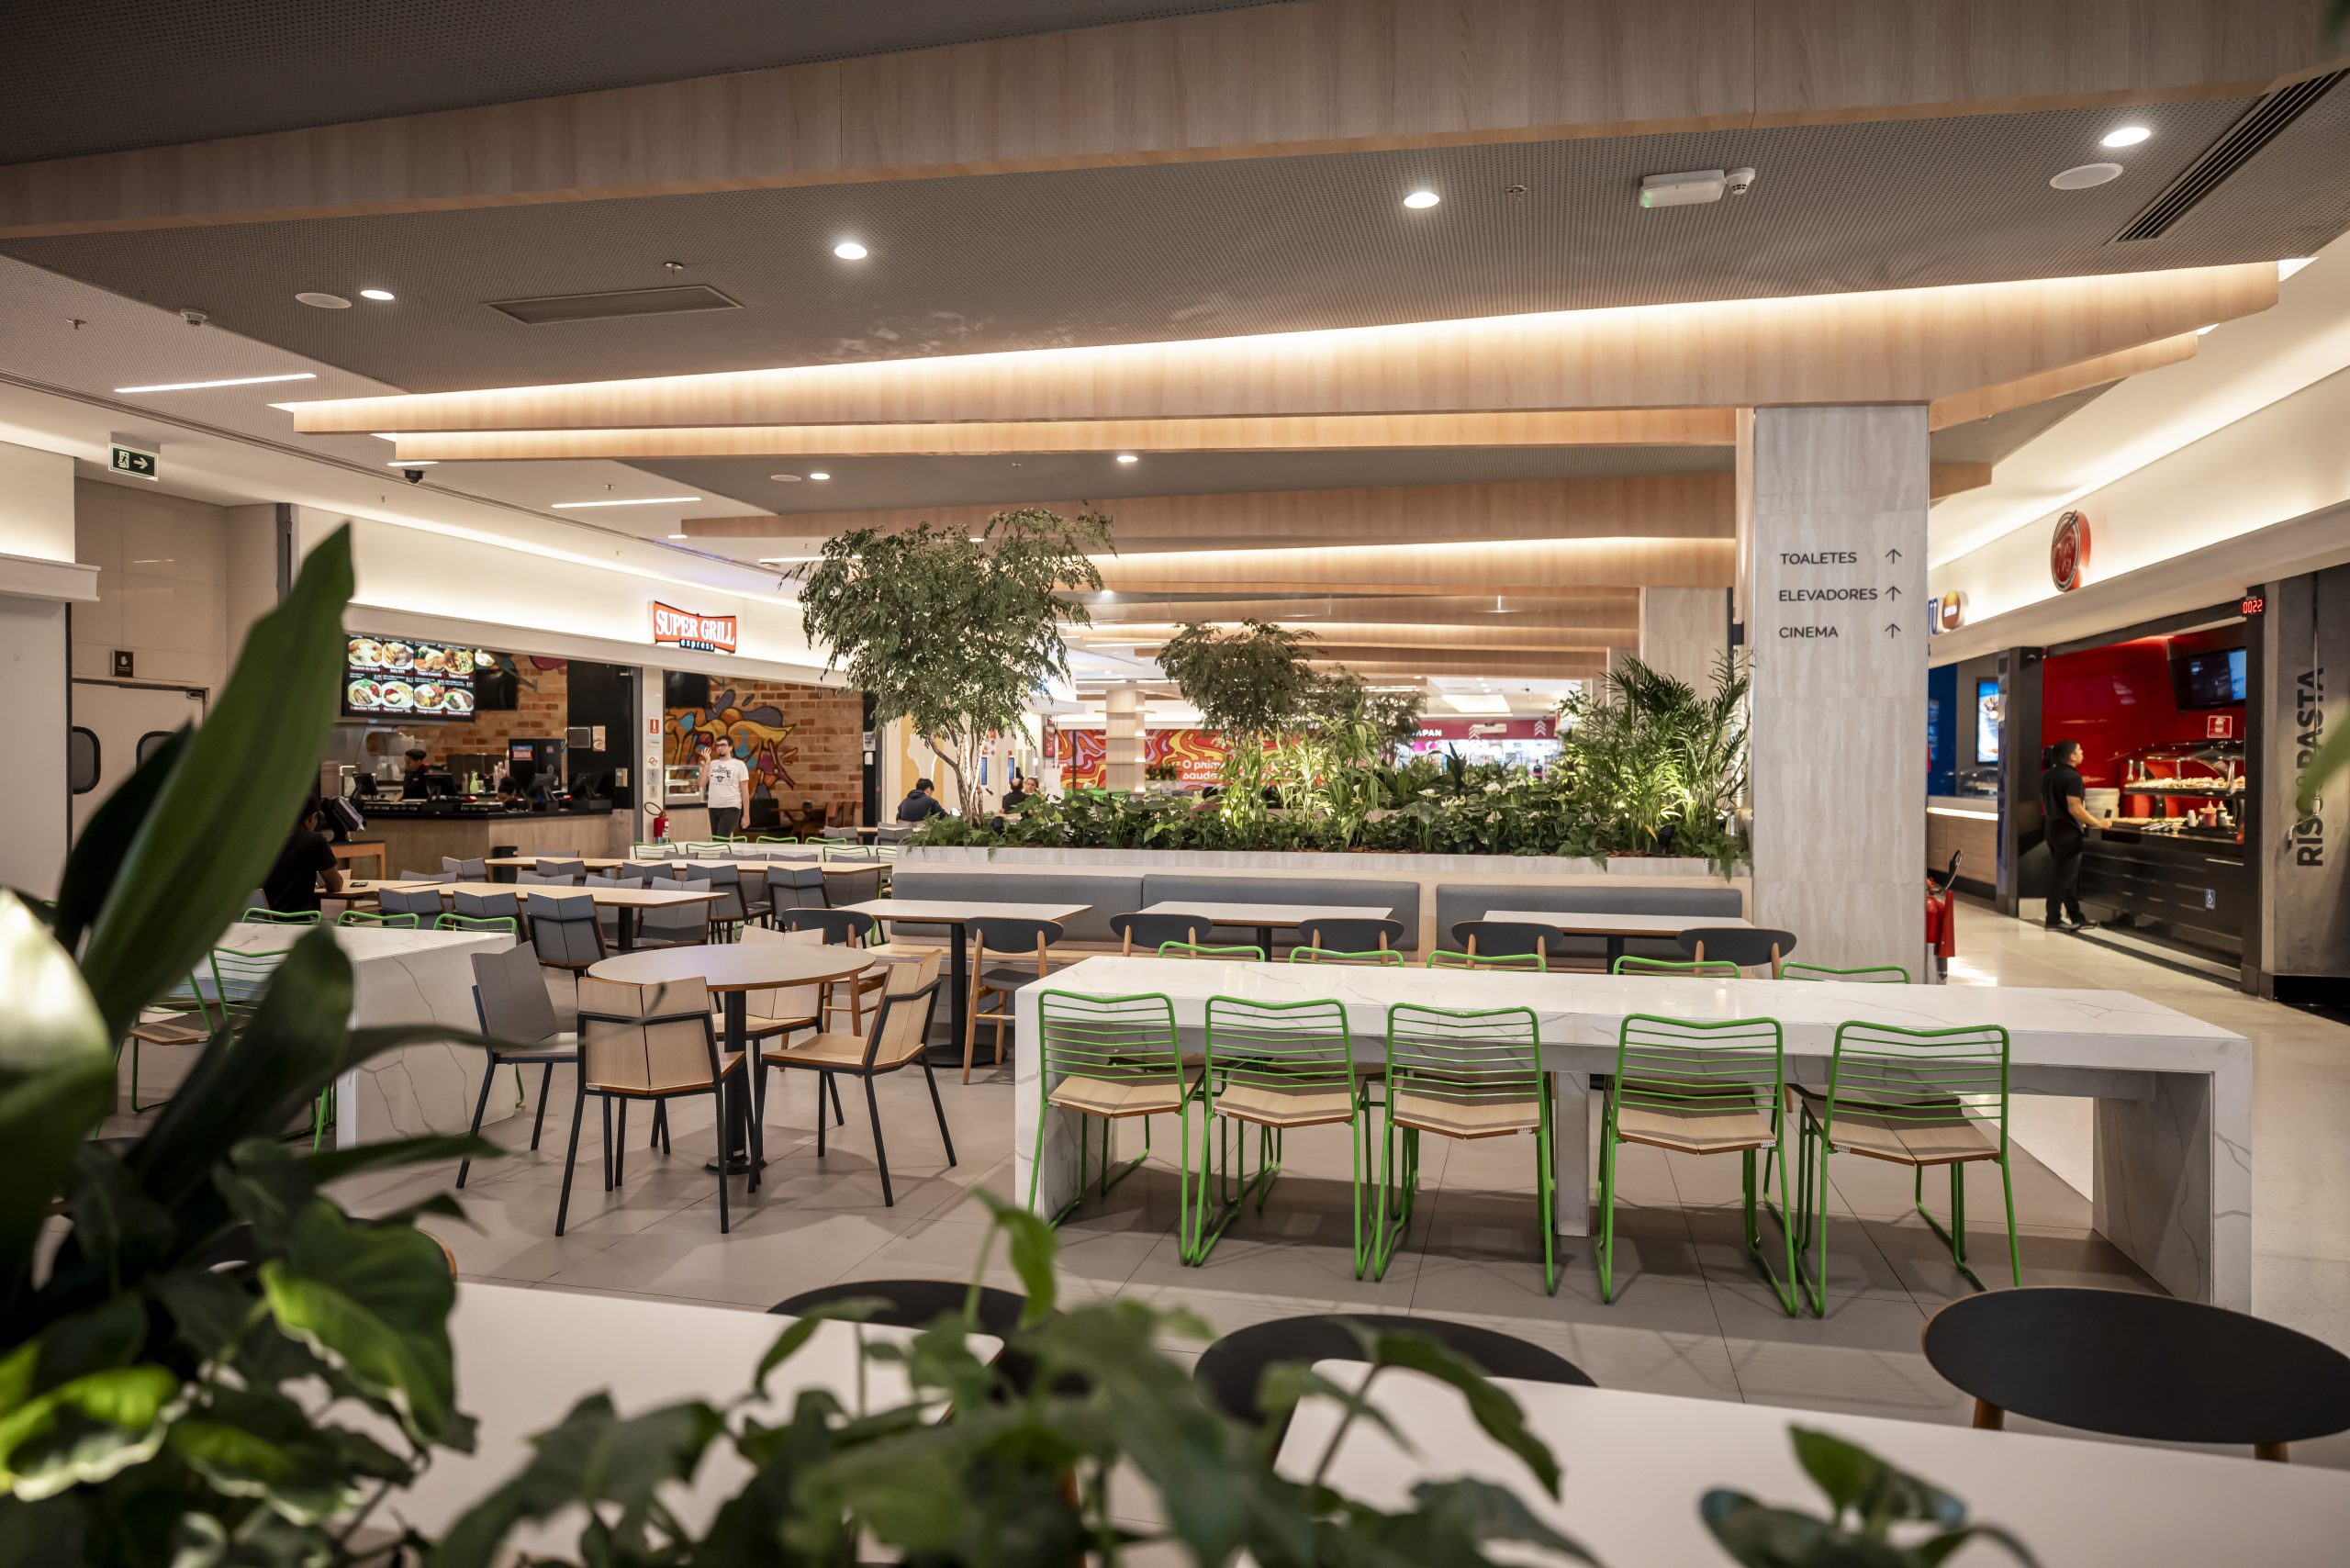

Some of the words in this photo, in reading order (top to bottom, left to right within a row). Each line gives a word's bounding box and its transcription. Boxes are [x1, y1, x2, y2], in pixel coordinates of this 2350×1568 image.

[1780, 552, 1857, 565] TOALETES
[1779, 588, 1877, 601] ELEVADORES
[2243, 599, 2263, 614] 0022
[655, 609, 698, 638] SUPER
[700, 619, 735, 645] GRILL
[1779, 626, 1839, 638] CINEMA
[680, 639, 714, 650] express
[1412, 729, 1442, 737] APAN
[1182, 759, 1192, 769] O
